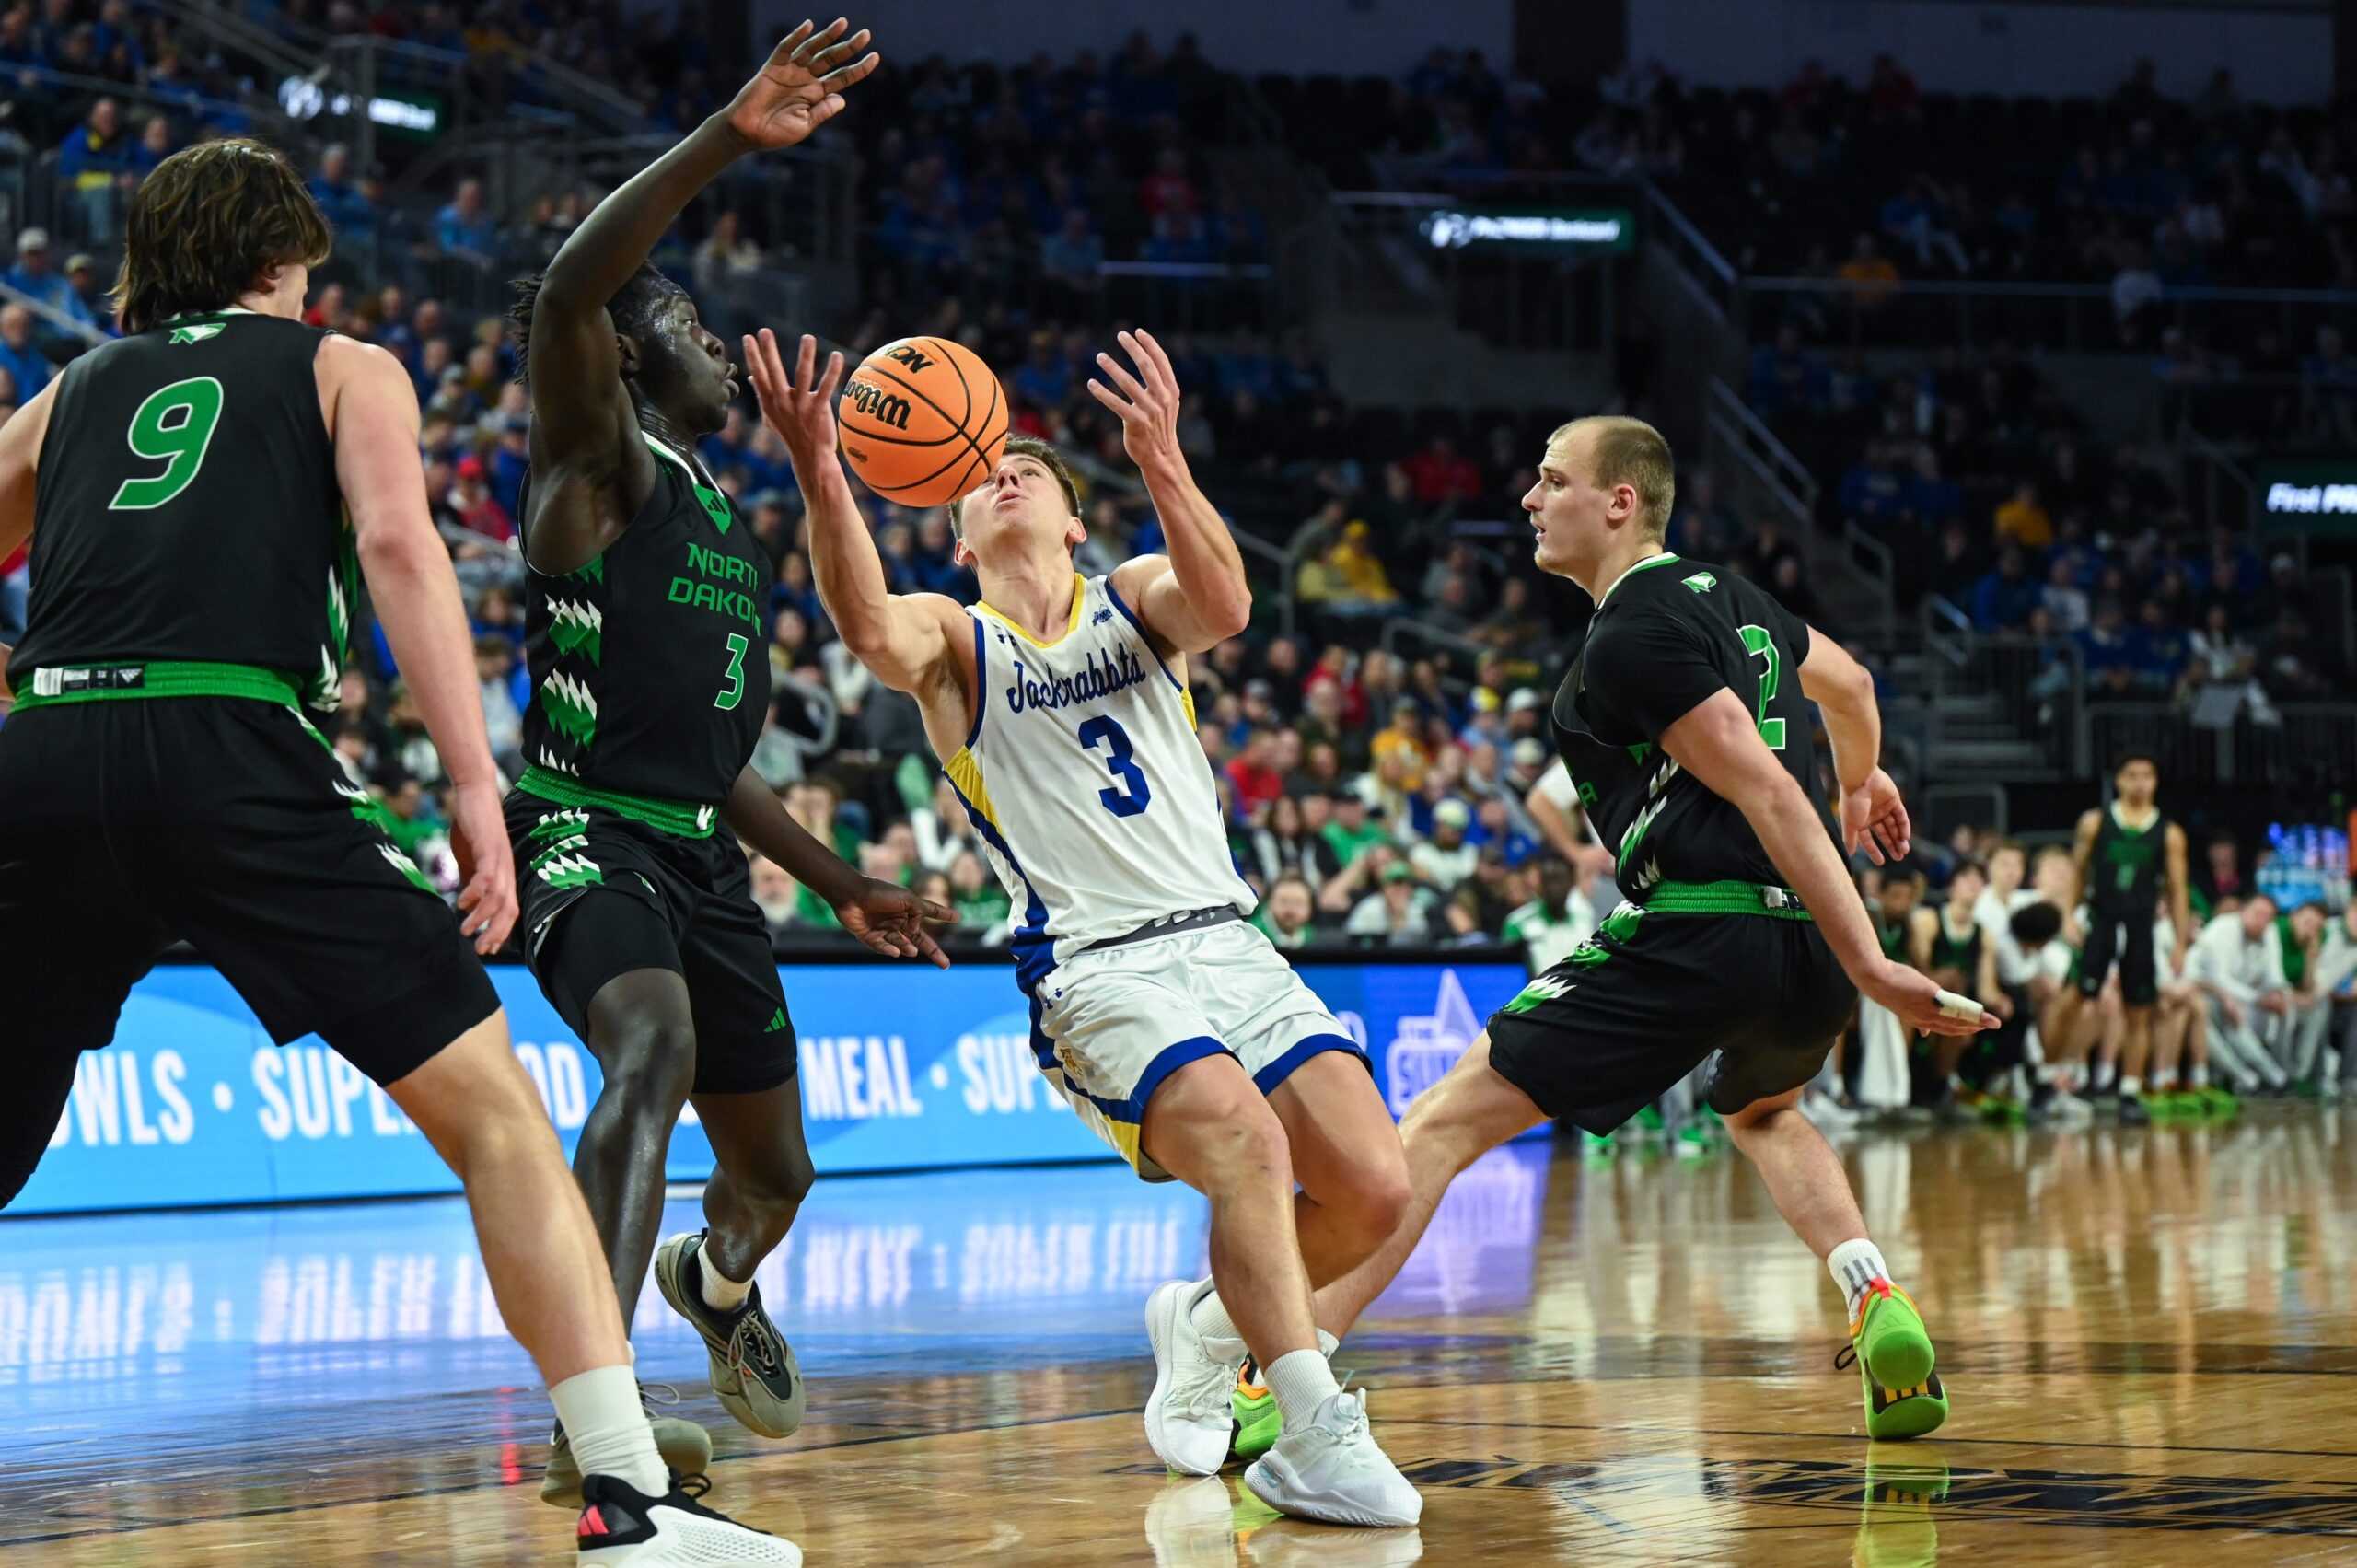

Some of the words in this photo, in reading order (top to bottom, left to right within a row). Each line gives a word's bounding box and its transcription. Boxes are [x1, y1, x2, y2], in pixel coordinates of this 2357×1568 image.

[108, 376, 224, 510] 9
[714, 633, 749, 711] 3
[1006, 642, 1147, 714] Jackrabbts
[1736, 624, 1786, 750] 2
[1078, 714, 1151, 818] 3
[251, 1046, 418, 1141] SUPE
[800, 1035, 923, 1121] MEAL
